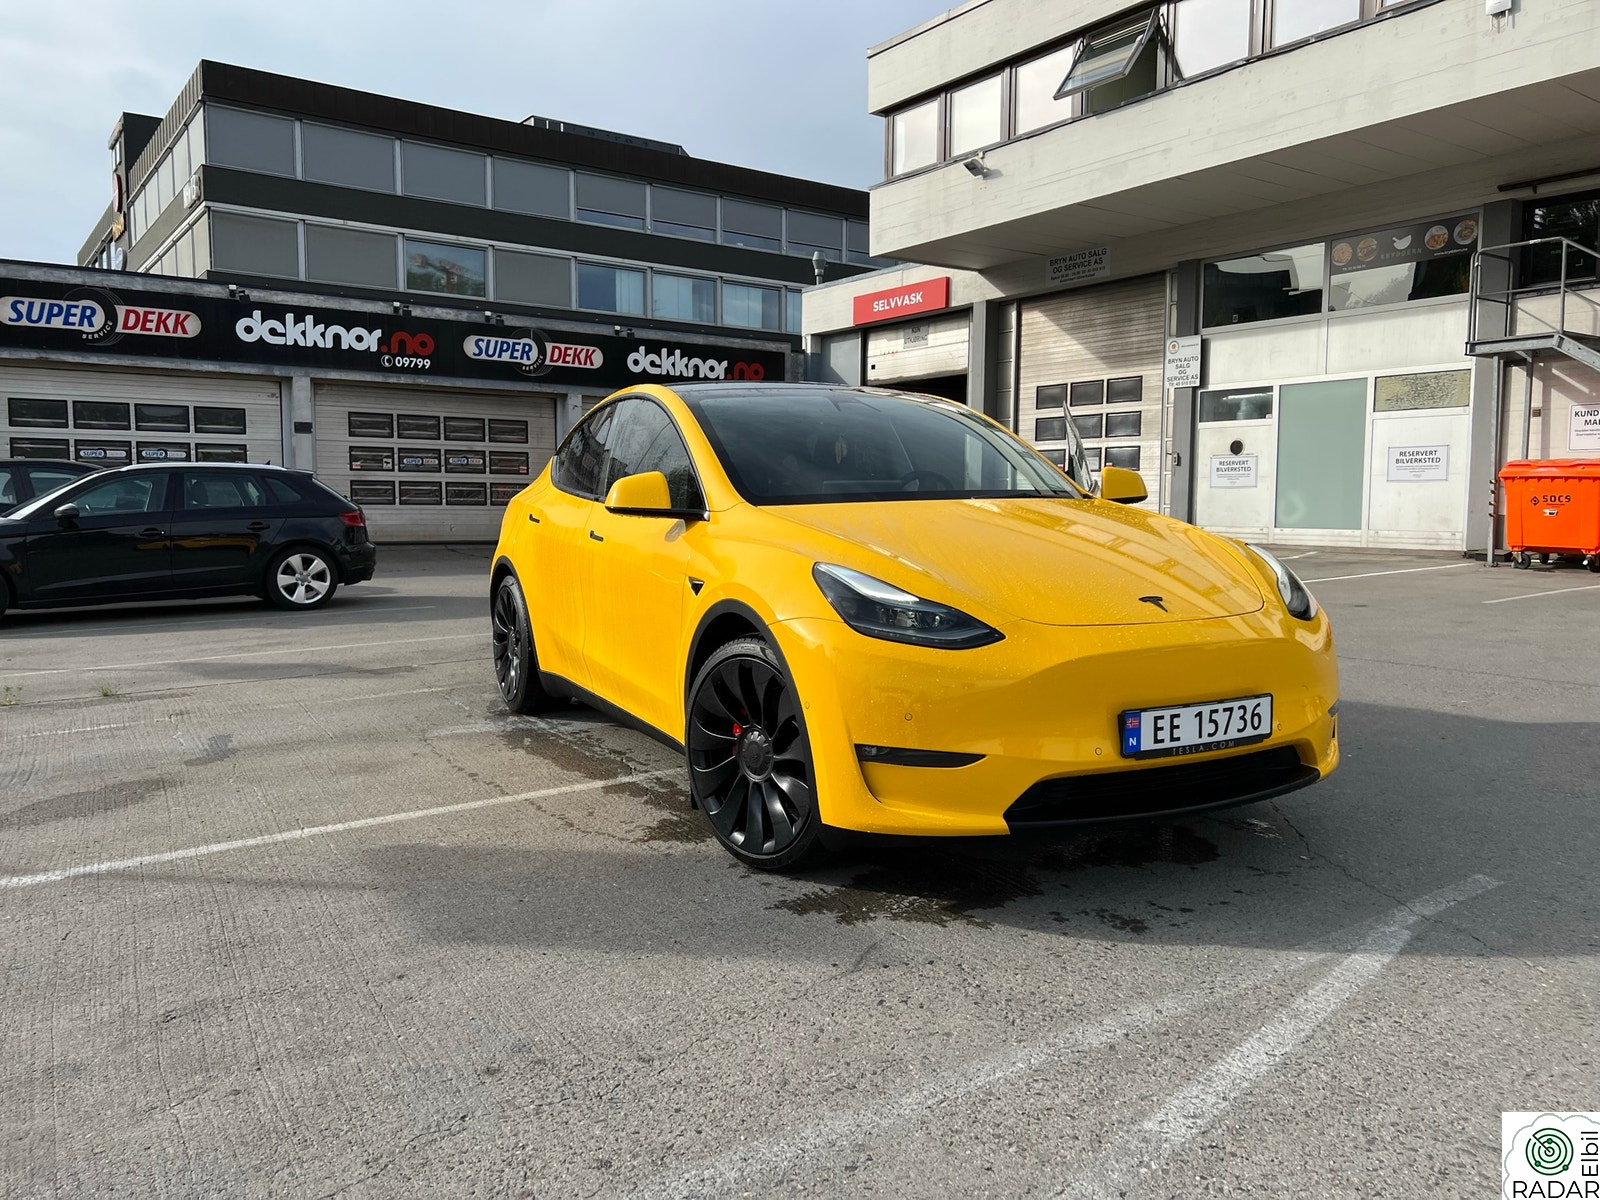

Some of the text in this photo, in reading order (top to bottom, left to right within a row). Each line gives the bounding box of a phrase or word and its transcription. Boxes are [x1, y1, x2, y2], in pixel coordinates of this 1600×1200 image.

[1050, 248, 1107, 267] BRYN AUTO SALG
[1052, 265, 1062, 274] OG
[1063, 259, 1092, 271] SERVICE
[1093, 257, 1104, 266] AS
[872, 291, 923, 312] SELVVASK
[8, 299, 192, 335] SUPER DEKK
[82, 319, 114, 340] SERVICE
[472, 338, 597, 367] SUPER DEKK
[395, 356, 431, 369] 09799
[521, 355, 544, 371] SERVICE
[1166, 374, 1190, 382] SERVICE
[1542, 494, 1571, 503] SOCS
[1153, 702, 1262, 744] EE 15736
[1129, 737, 1137, 746] N
[1172, 741, 1235, 755] TESLA.COM
